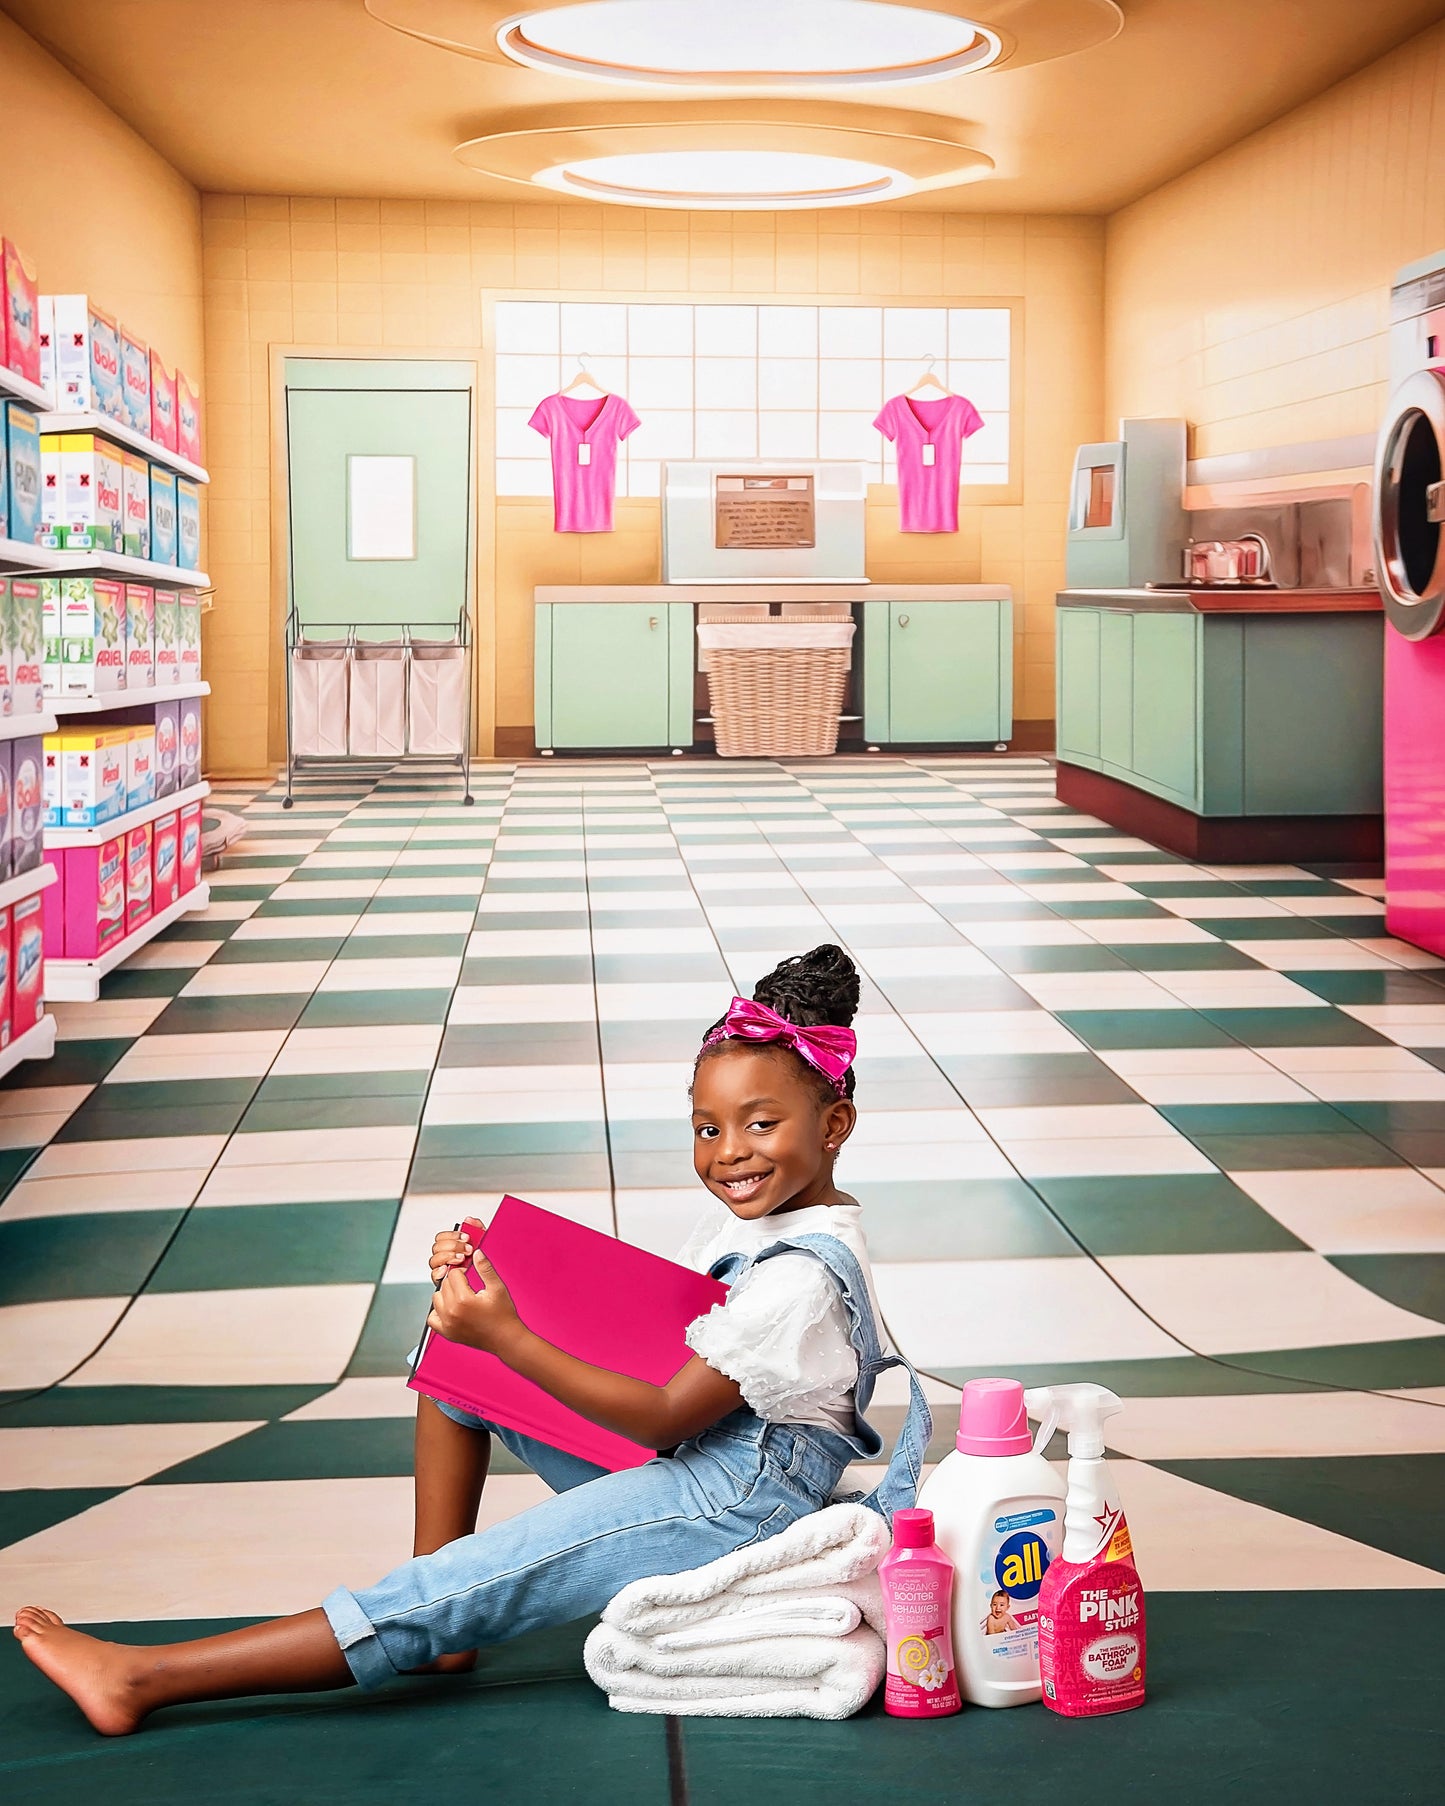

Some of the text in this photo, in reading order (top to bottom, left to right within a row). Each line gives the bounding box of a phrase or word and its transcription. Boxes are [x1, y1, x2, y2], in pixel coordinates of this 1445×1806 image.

[93, 340, 117, 375] Bold
[126, 364, 147, 396] Bold
[97, 480, 119, 512] Persil
[127, 492, 146, 521] Persil
[96, 650, 124, 668] ARIEL
[128, 650, 152, 666] ARIEL
[157, 650, 178, 665] ARIEL
[181, 650, 199, 665] ARIEL
[15, 664, 42, 685] ARIEL
[1002, 1541, 1042, 1587] all
[888, 1581, 939, 1592] FRAGRANCE
[1080, 1589, 1109, 1601] THE
[894, 1591, 934, 1601] BOOSTER
[1080, 1591, 1139, 1623] PINK
[1104, 1612, 1139, 1632] STUFF
[1088, 1645, 1137, 1662] BATHROOM
[1109, 1643, 1128, 1652] MIRACLE
[1102, 1656, 1127, 1668] FOAM
